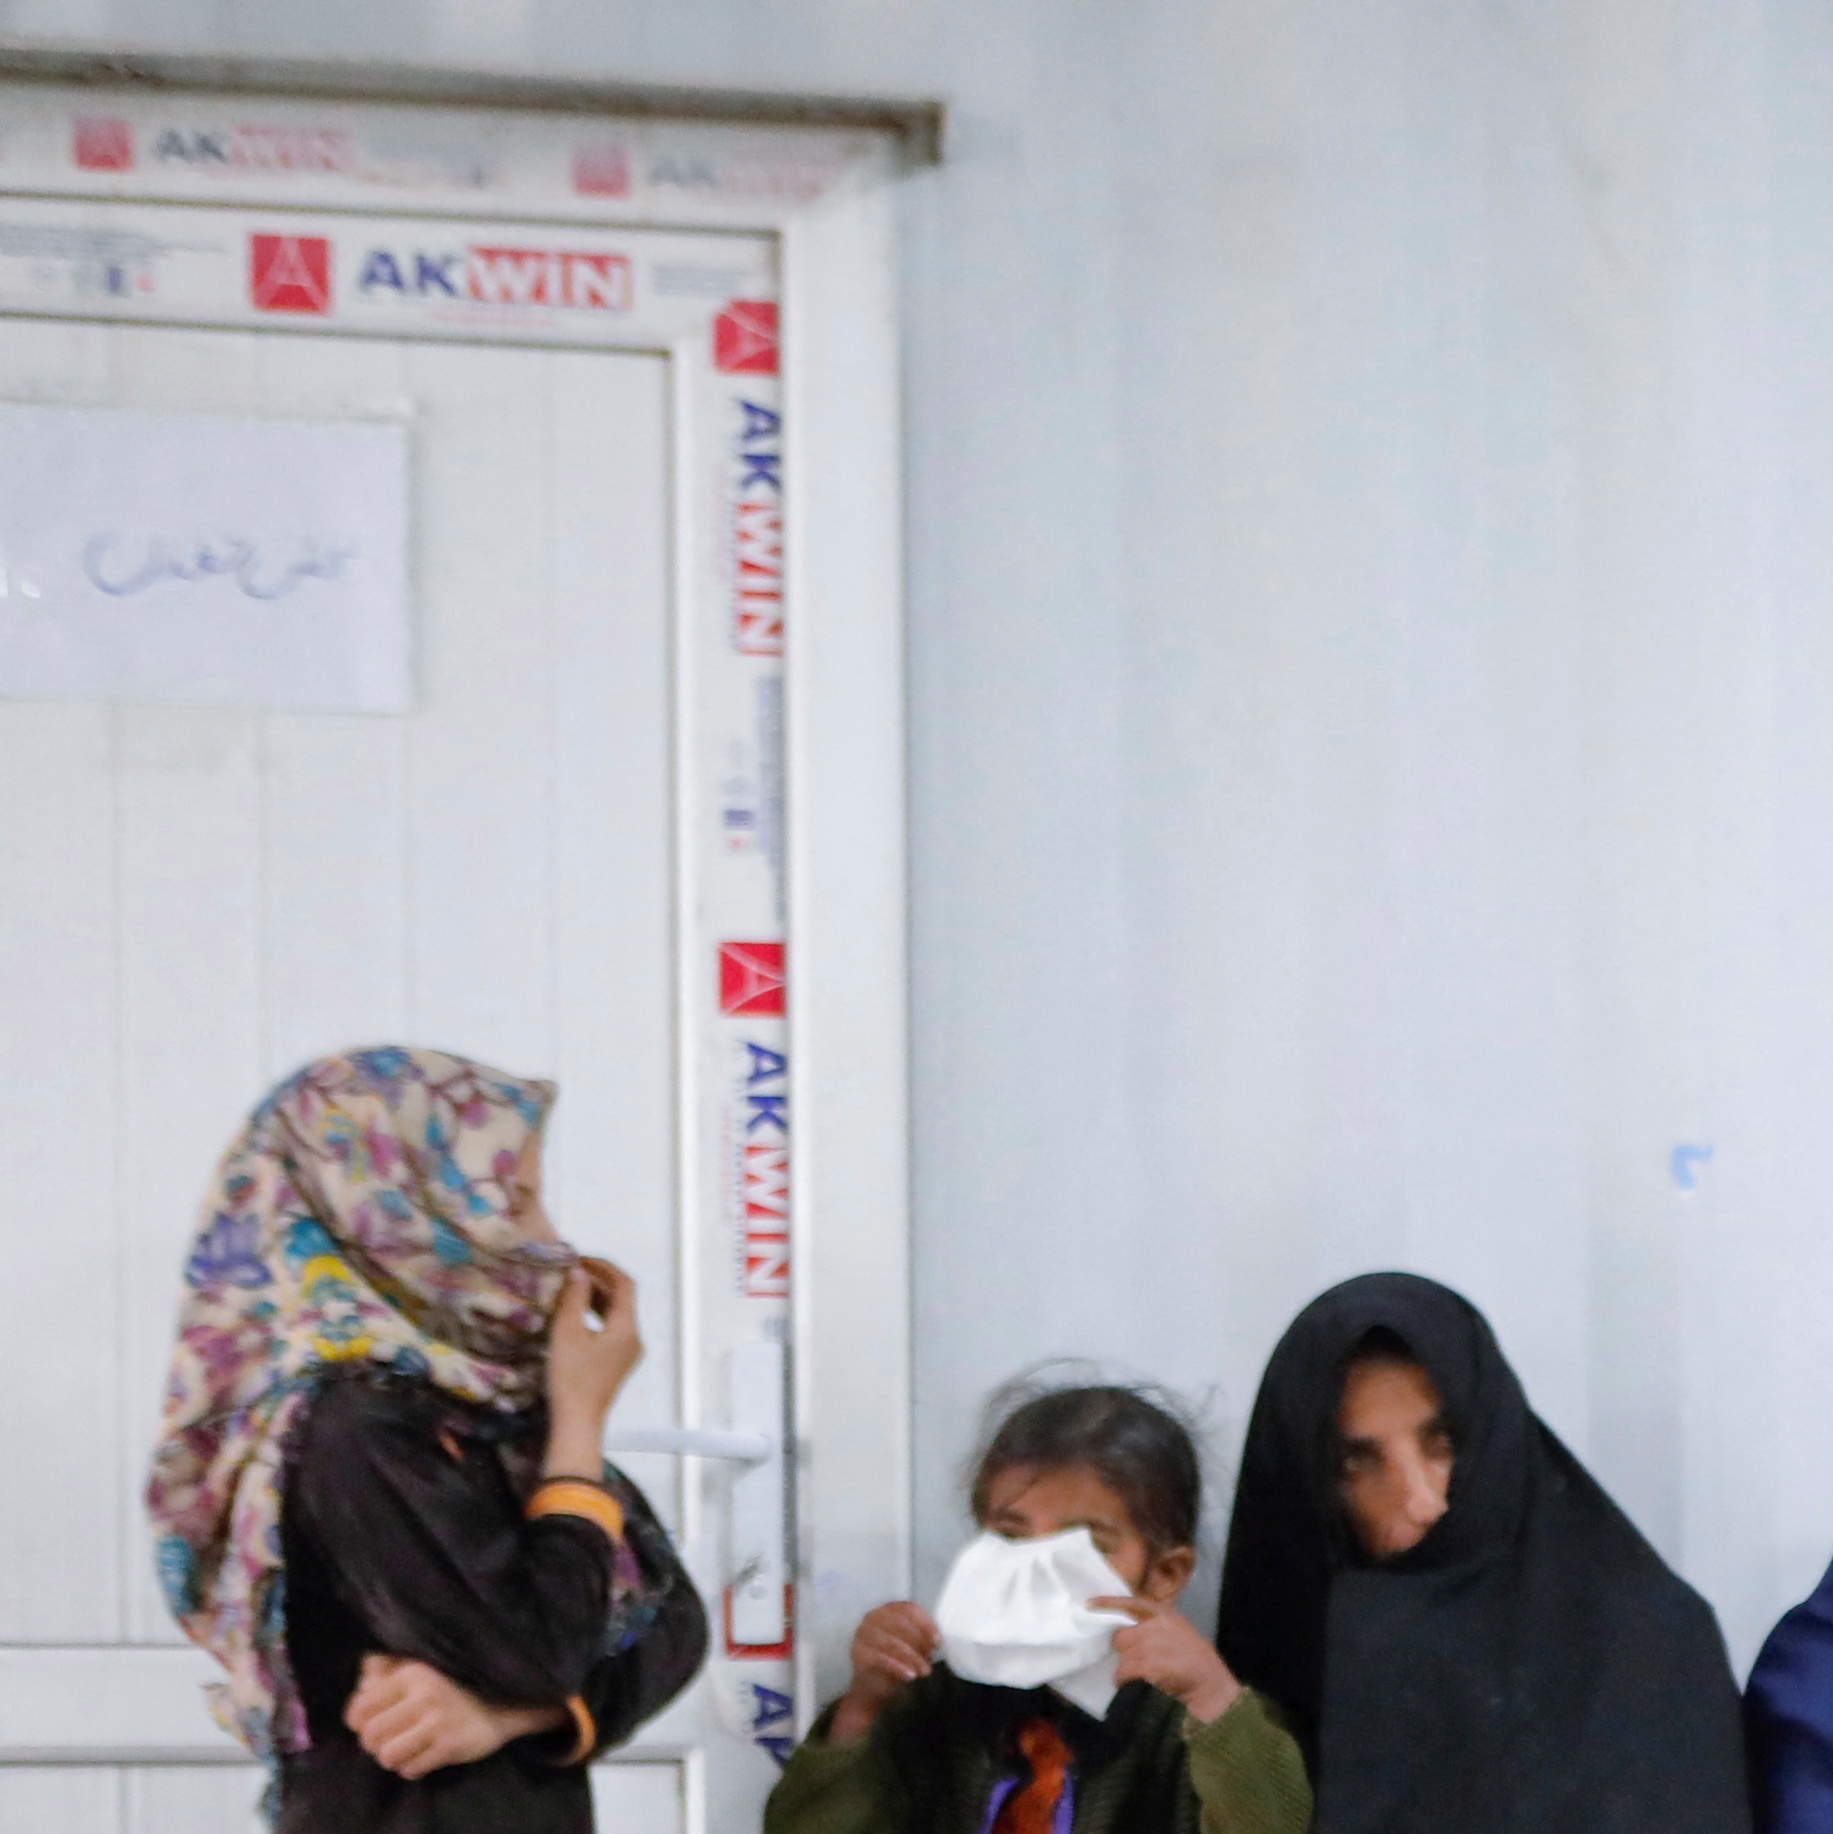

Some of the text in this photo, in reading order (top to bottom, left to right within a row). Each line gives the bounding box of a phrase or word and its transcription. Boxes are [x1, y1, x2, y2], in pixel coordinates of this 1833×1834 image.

[358, 246, 634, 311] AKWIN
[737, 398, 784, 657] AKWIN
[744, 1042, 790, 1299] AKWIN
